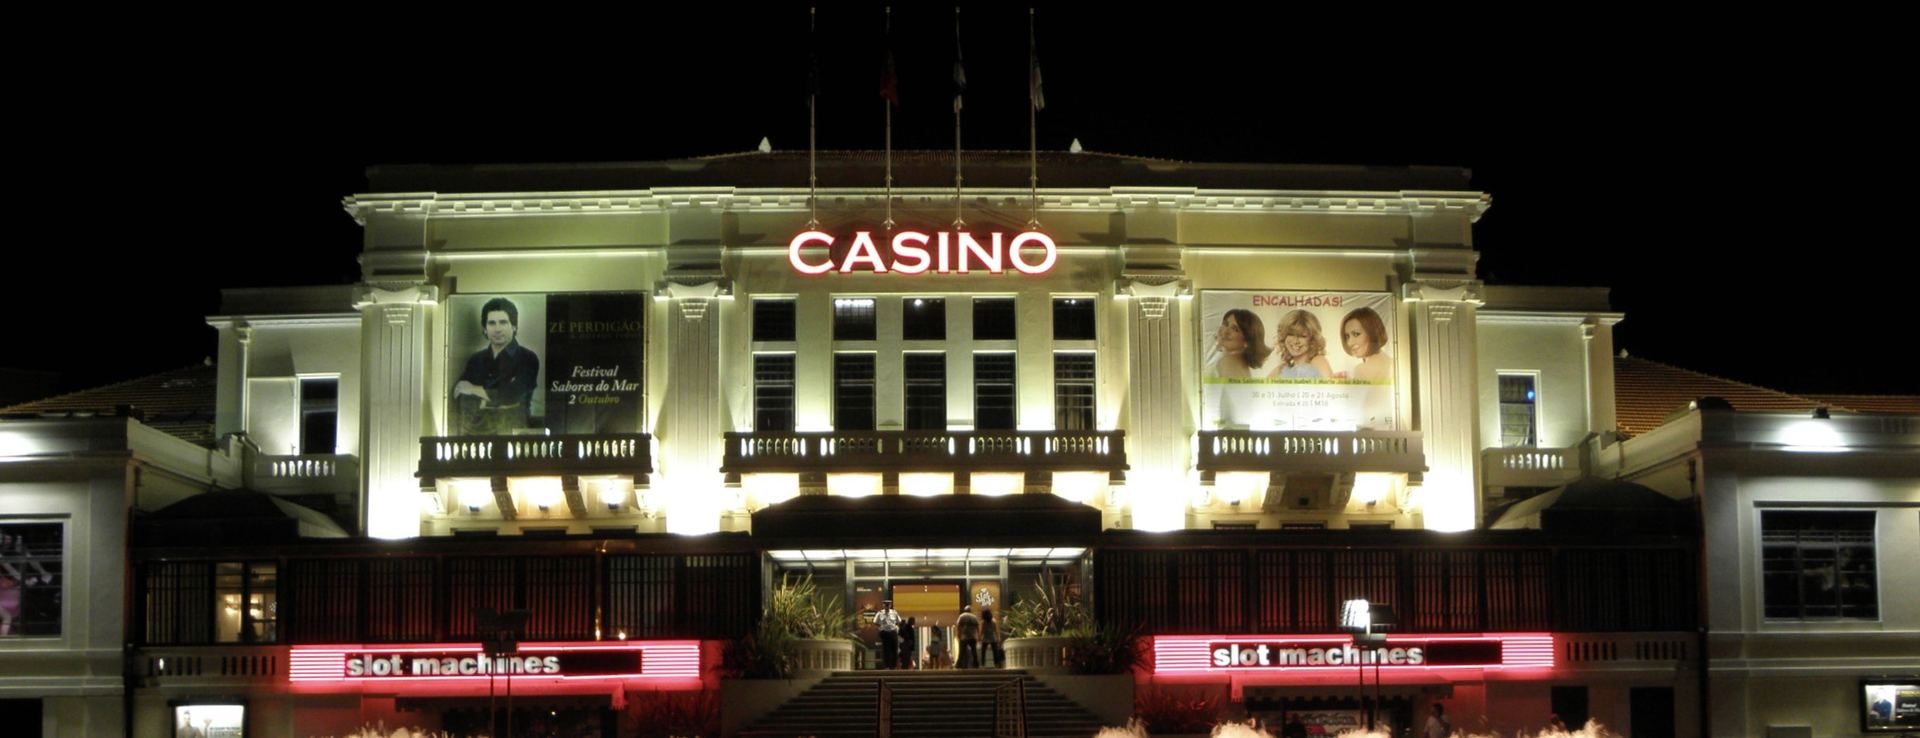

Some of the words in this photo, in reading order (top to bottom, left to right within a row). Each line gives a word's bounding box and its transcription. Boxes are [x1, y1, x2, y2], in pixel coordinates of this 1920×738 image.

[788, 230, 1058, 275] CASINO
[1252, 295, 1343, 307] ENCALHADAS!
[572, 365, 619, 377] Festival
[551, 380, 593, 392] Sabores
[595, 380, 609, 392] do
[612, 379, 639, 391] Mar
[568, 394, 576, 404] 2
[578, 394, 620, 404] Outubro
[1213, 644, 1269, 666] slot
[1279, 642, 1424, 665] machines
[346, 654, 403, 676] slot
[412, 652, 560, 675] machines
